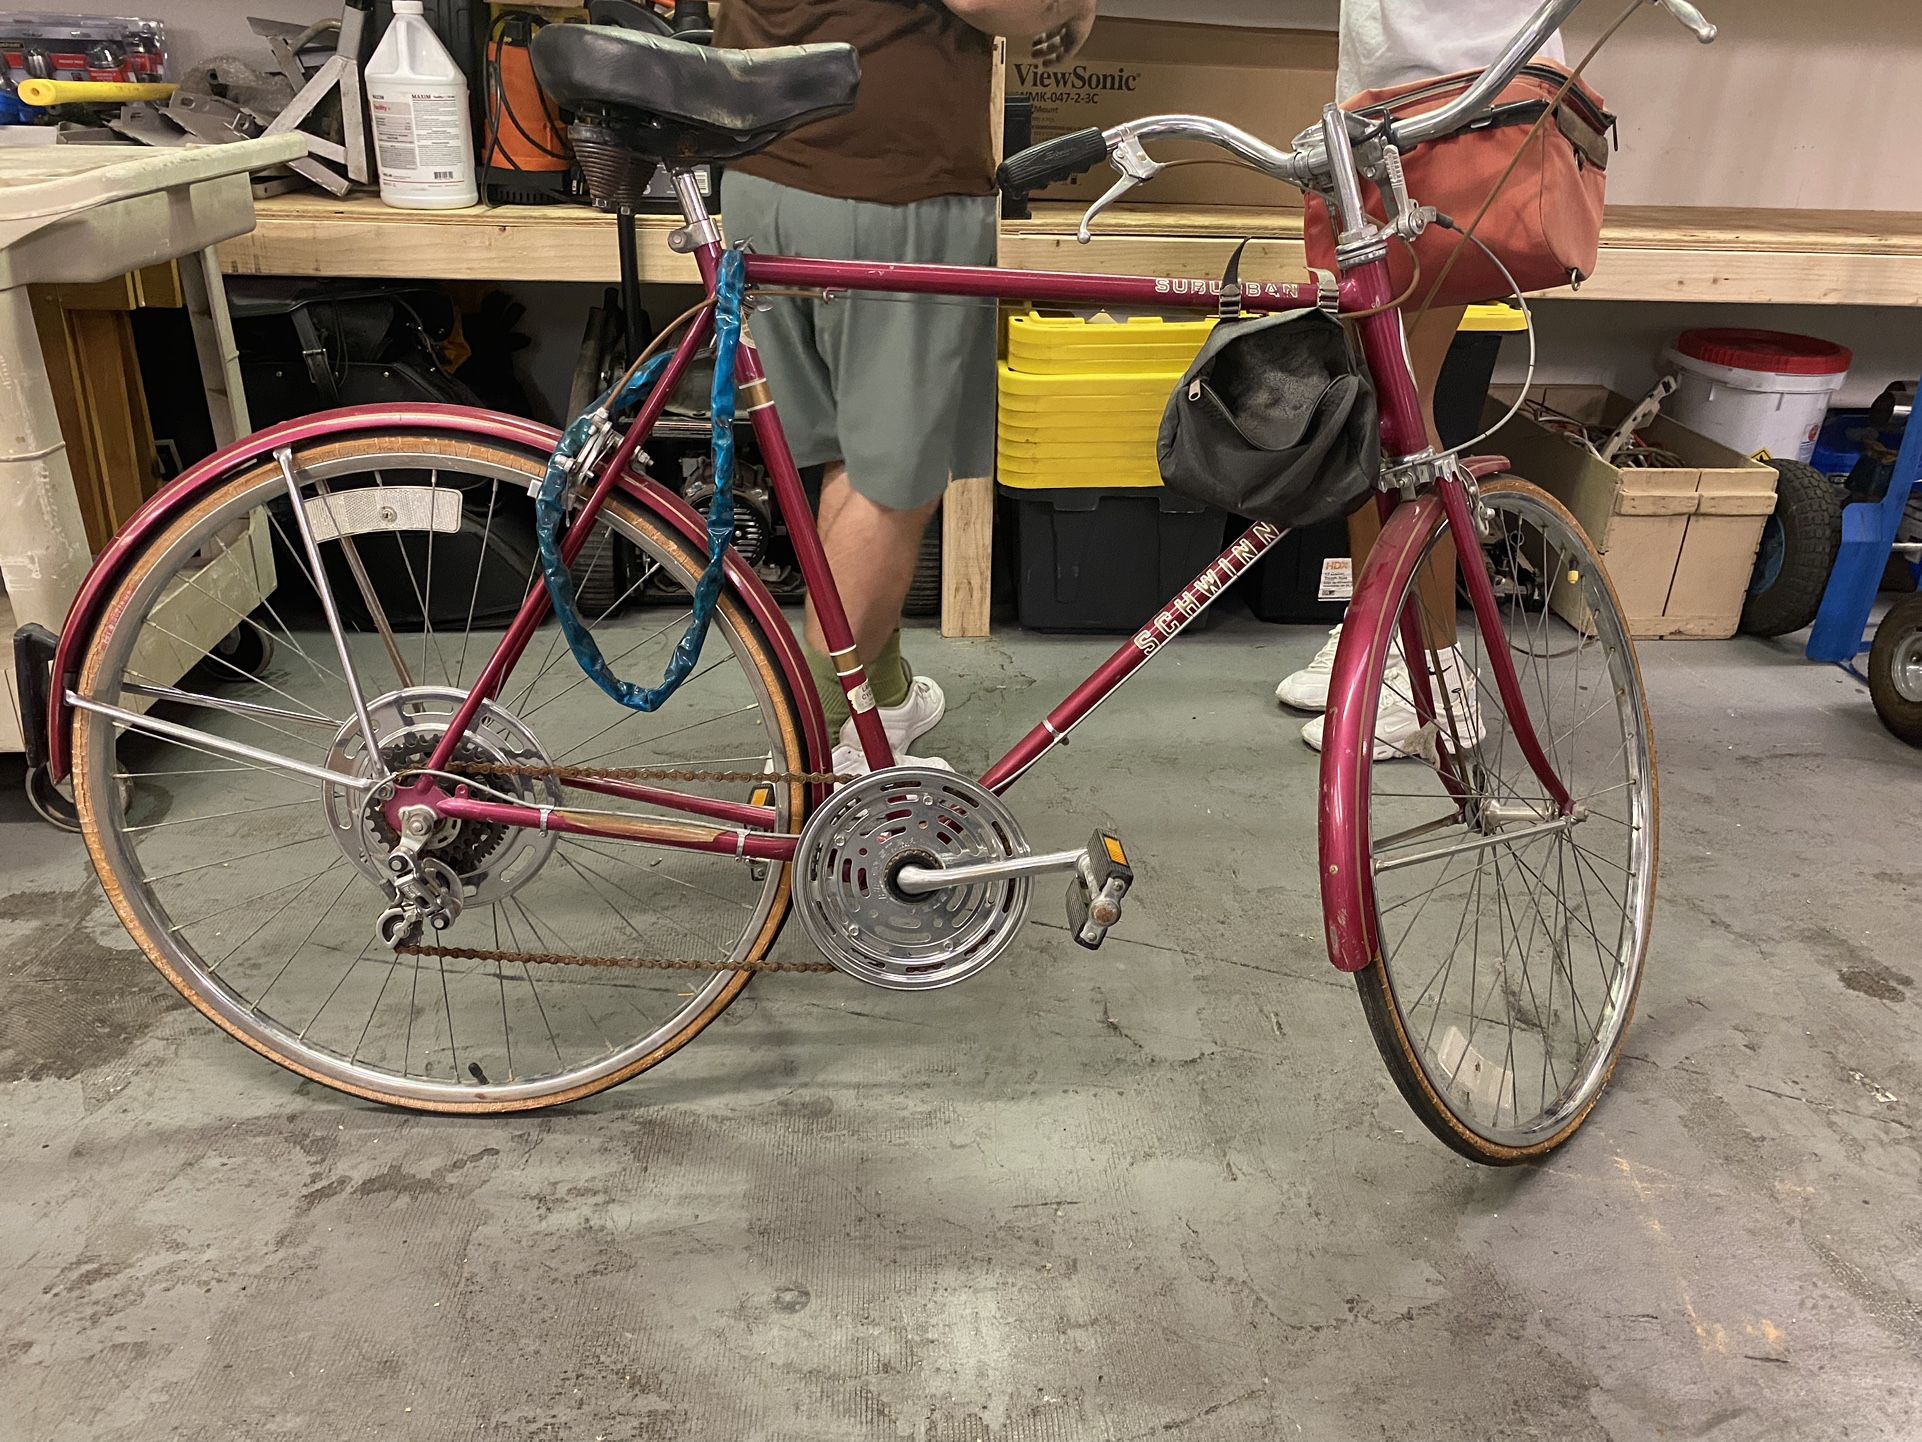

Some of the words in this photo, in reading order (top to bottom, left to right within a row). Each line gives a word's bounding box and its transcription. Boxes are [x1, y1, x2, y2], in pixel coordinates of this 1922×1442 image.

[1014, 63, 1138, 92] ViewSonic
[1154, 277, 1298, 298] SUBUBAN
[1326, 561, 1348, 570] HDX
[1133, 521, 1280, 656] SCHWINN
